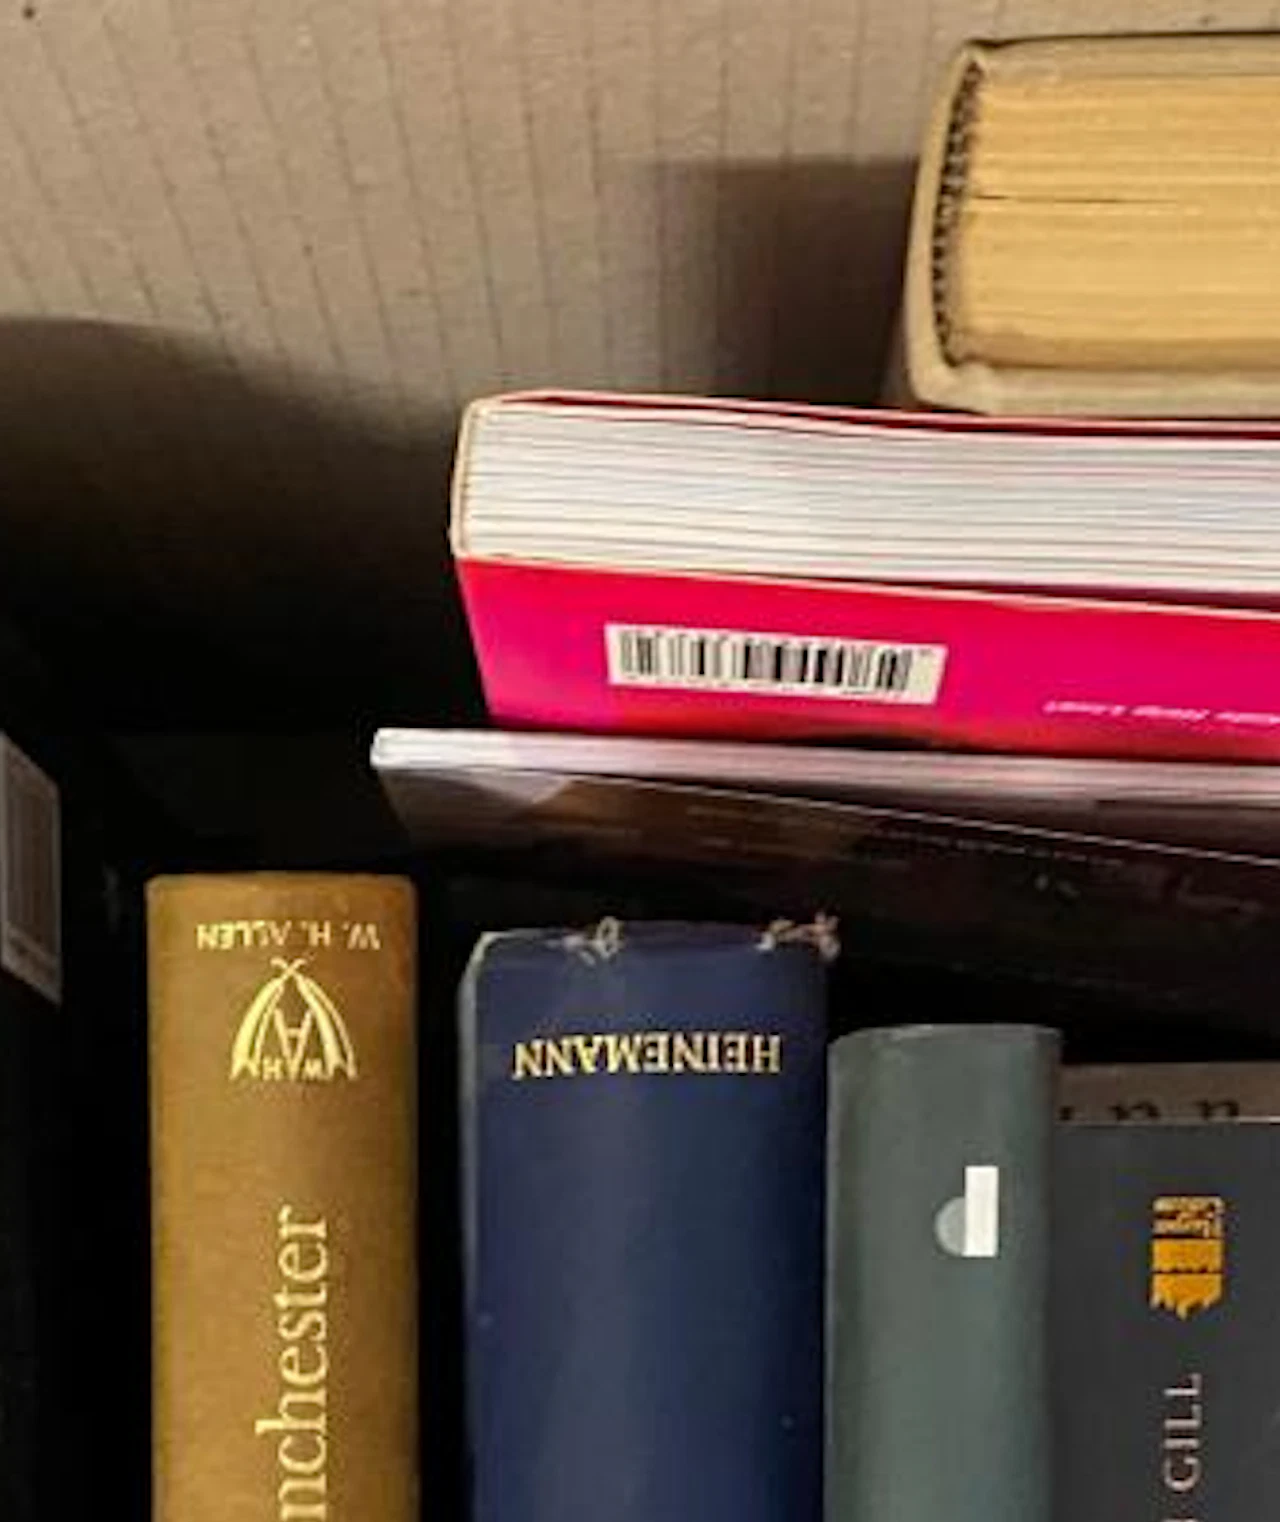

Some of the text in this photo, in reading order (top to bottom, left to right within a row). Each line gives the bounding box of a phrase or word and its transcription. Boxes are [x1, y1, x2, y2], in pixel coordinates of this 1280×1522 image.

[196, 920, 293, 950] ALLEN
[511, 1032, 782, 1082] HEINEMANN
[1161, 1372, 1203, 1494] GILL
